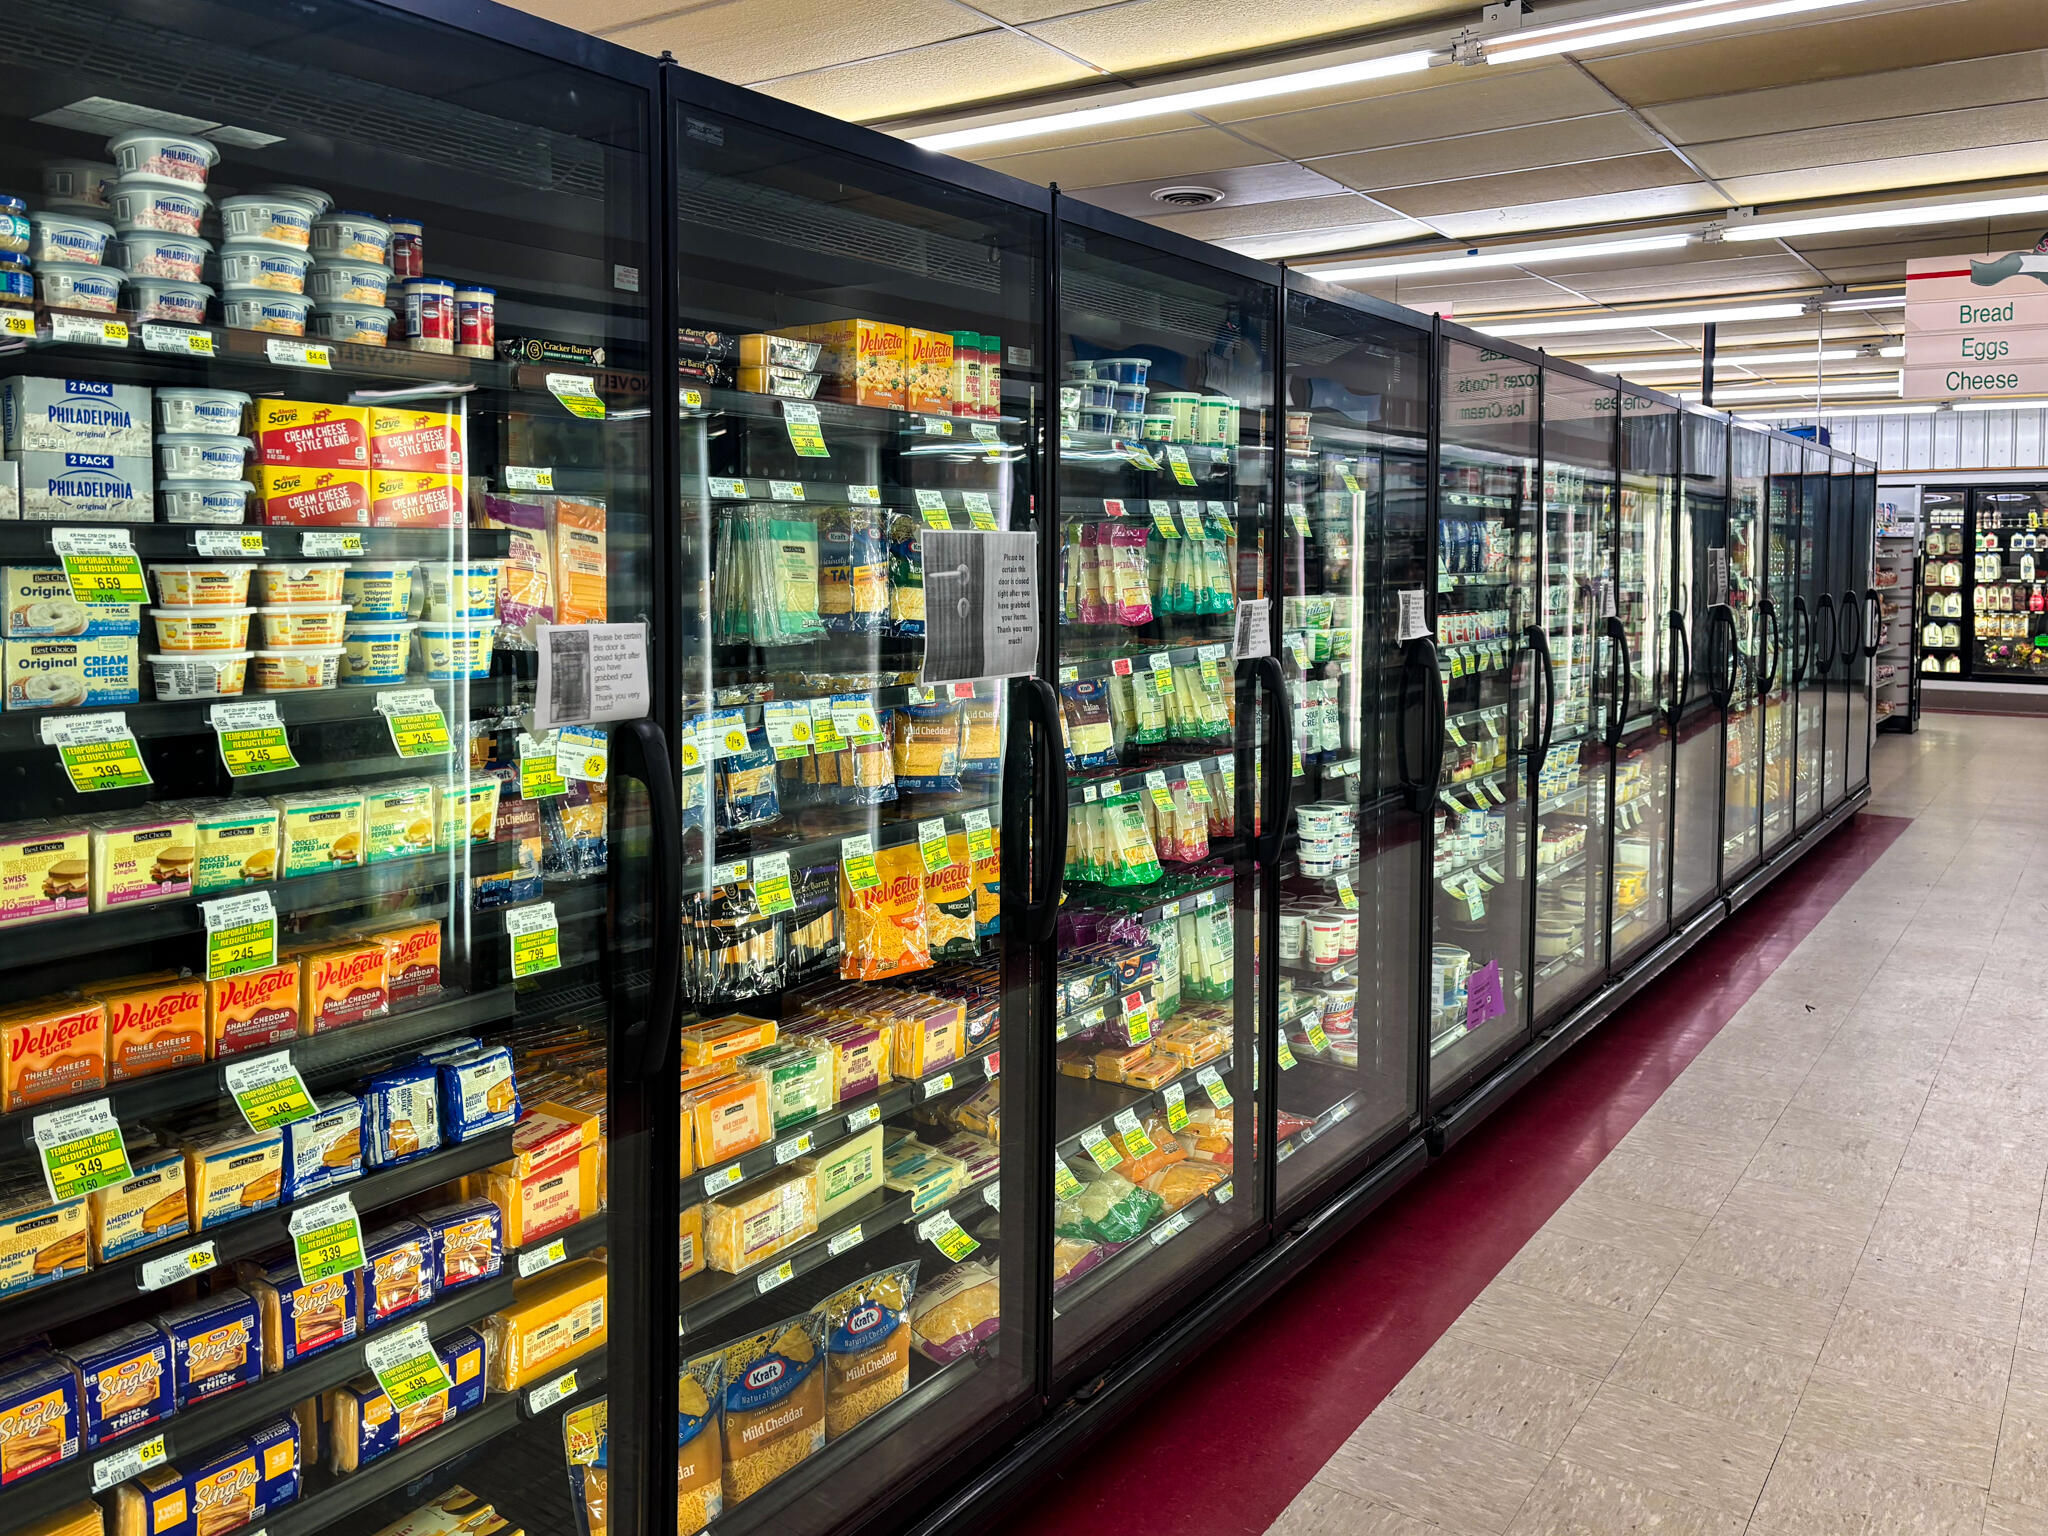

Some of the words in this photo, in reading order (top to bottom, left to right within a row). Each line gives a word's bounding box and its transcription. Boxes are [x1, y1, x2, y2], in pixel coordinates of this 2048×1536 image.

[161, 147, 206, 165] PHILADELPHIA
[155, 200, 200, 216] PHILADELPHIA
[1960, 302, 2014, 324] Bread
[686, 328, 705, 337] Barrel
[860, 328, 903, 352] Velveeta
[544, 342, 570, 352] Cracker
[571, 346, 591, 355] Barrel
[913, 336, 952, 359] Velveeta
[1962, 338, 2009, 360] Eggs
[688, 360, 705, 368] Barrel
[70, 382, 77, 391] 2
[79, 383, 109, 394] PACK
[1946, 371, 2018, 391] Cheese
[48, 405, 132, 428] PHILADELPHIA
[194, 405, 238, 418] PHILADELPHIA
[268, 412, 298, 424] Save
[284, 429, 313, 443] CREAM
[315, 422, 347, 437] CHEESE
[374, 419, 400, 429] Save
[76, 430, 106, 439] original
[388, 434, 414, 448] CREAM
[416, 428, 444, 442] CHEESE
[296, 440, 321, 453] STYLE
[324, 434, 350, 448] BLEND
[398, 444, 422, 457] STYLE
[425, 440, 446, 453] BLEND
[70, 456, 77, 465] 2
[79, 456, 109, 466] PACK
[202, 451, 243, 463] PHILADELPHIA
[48, 479, 133, 499] PHILADELPHIA
[272, 478, 300, 490] Save
[288, 496, 316, 509] CREAM
[318, 486, 349, 501] CHEESE
[76, 502, 107, 511] original
[299, 504, 325, 518] STYLE
[327, 497, 352, 512] BLEND
[34, 646, 51, 654] Best
[19, 656, 77, 670] Original
[83, 655, 128, 666] CREAM
[594, 665, 605, 673] you
[83, 667, 128, 677] CHEESE
[65, 743, 109, 756] TEMPORARY
[110, 741, 131, 751] PRICE
[76, 751, 127, 762] REDUCTION!
[505, 811, 535, 824] Cheddar
[292, 845, 314, 853] PEPPER
[316, 843, 330, 851] JACK
[113, 861, 137, 870] SWISS
[200, 855, 229, 865] PROCESS
[200, 862, 223, 871] PEPPER
[225, 860, 242, 868] JACK
[3, 874, 27, 884] SWISS
[941, 880, 970, 894] SHREDS
[948, 903, 969, 911] MEXICAN
[316, 952, 384, 991] Velveeta
[219, 969, 296, 1012] Velveeta
[243, 994, 271, 1010] SLICES
[324, 999, 347, 1010] SHARP
[348, 990, 381, 1004] CHEDDAR
[112, 990, 202, 1035] Velveeta
[140, 1017, 173, 1032] SLICES
[226, 1019, 251, 1032] SHARP
[253, 1011, 290, 1026] CHEDDAR
[11, 1013, 102, 1062] Velveeta
[124, 1042, 154, 1054] THREE
[156, 1036, 192, 1048] CHEESE
[40, 1041, 72, 1058] SLICES
[24, 1068, 54, 1082] THREE
[55, 1059, 91, 1074] CHEESE
[113, 1067, 123, 1075] 16
[50, 1138, 93, 1157] TEMPORARY
[95, 1131, 116, 1143] PRICE
[59, 1143, 110, 1164] REDUCTION!
[208, 1183, 244, 1198] AMERICAN
[532, 1198, 548, 1210] SHARP
[549, 1190, 569, 1204] CHEDDAR
[105, 1207, 144, 1225] AMERICAN
[290, 1282, 350, 1319] Singles
[854, 1313, 874, 1328] Kraft
[211, 1330, 226, 1340] Kraft
[844, 1334, 867, 1348] Natural
[868, 1323, 889, 1339] Cheese
[177, 1340, 188, 1349] 16
[185, 1328, 251, 1367] Singles
[752, 1364, 778, 1384] Kraft
[846, 1365, 866, 1382] Mild
[867, 1351, 898, 1373] Cheddar
[96, 1362, 165, 1403] Singles
[199, 1374, 236, 1393] THICK
[207, 1374, 227, 1384] ULTRA
[741, 1387, 770, 1405] Natural
[772, 1377, 794, 1395] Cheese
[110, 1408, 149, 1430] THICK
[120, 1408, 141, 1419] ULTRA
[742, 1421, 765, 1443] Mild
[766, 1406, 804, 1432] Cheddar
[16, 1455, 52, 1475] AMERICAN
[192, 1467, 262, 1513] Singles
